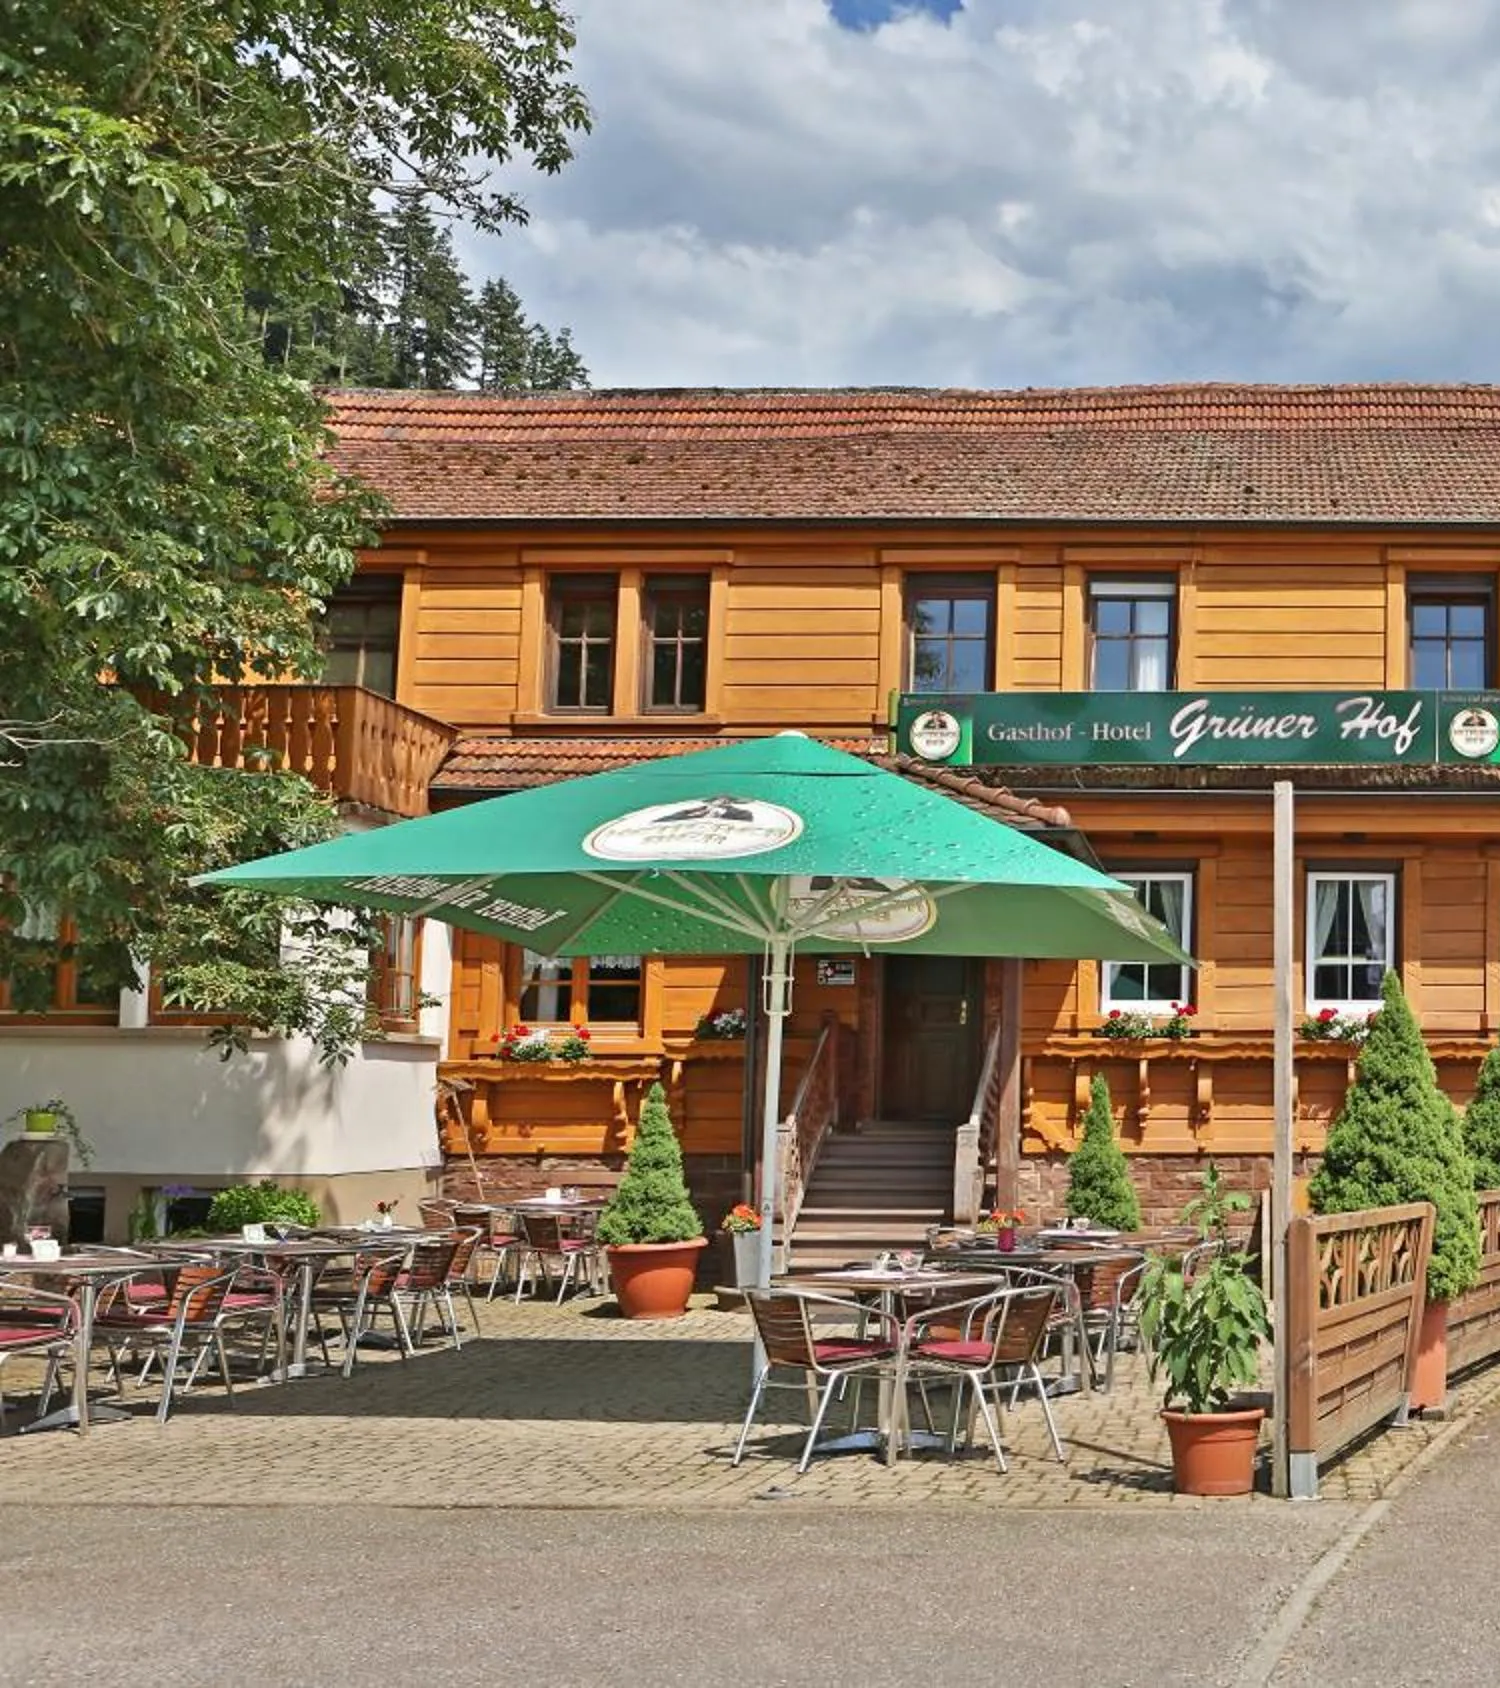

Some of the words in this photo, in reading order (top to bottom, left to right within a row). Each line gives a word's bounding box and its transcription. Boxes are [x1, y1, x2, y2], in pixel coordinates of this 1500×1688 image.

[988, 721, 1074, 741] Gasthof
[1092, 721, 1152, 741] Hotel
[1169, 699, 1319, 757] Grüner
[1335, 696, 1422, 755] Hof
